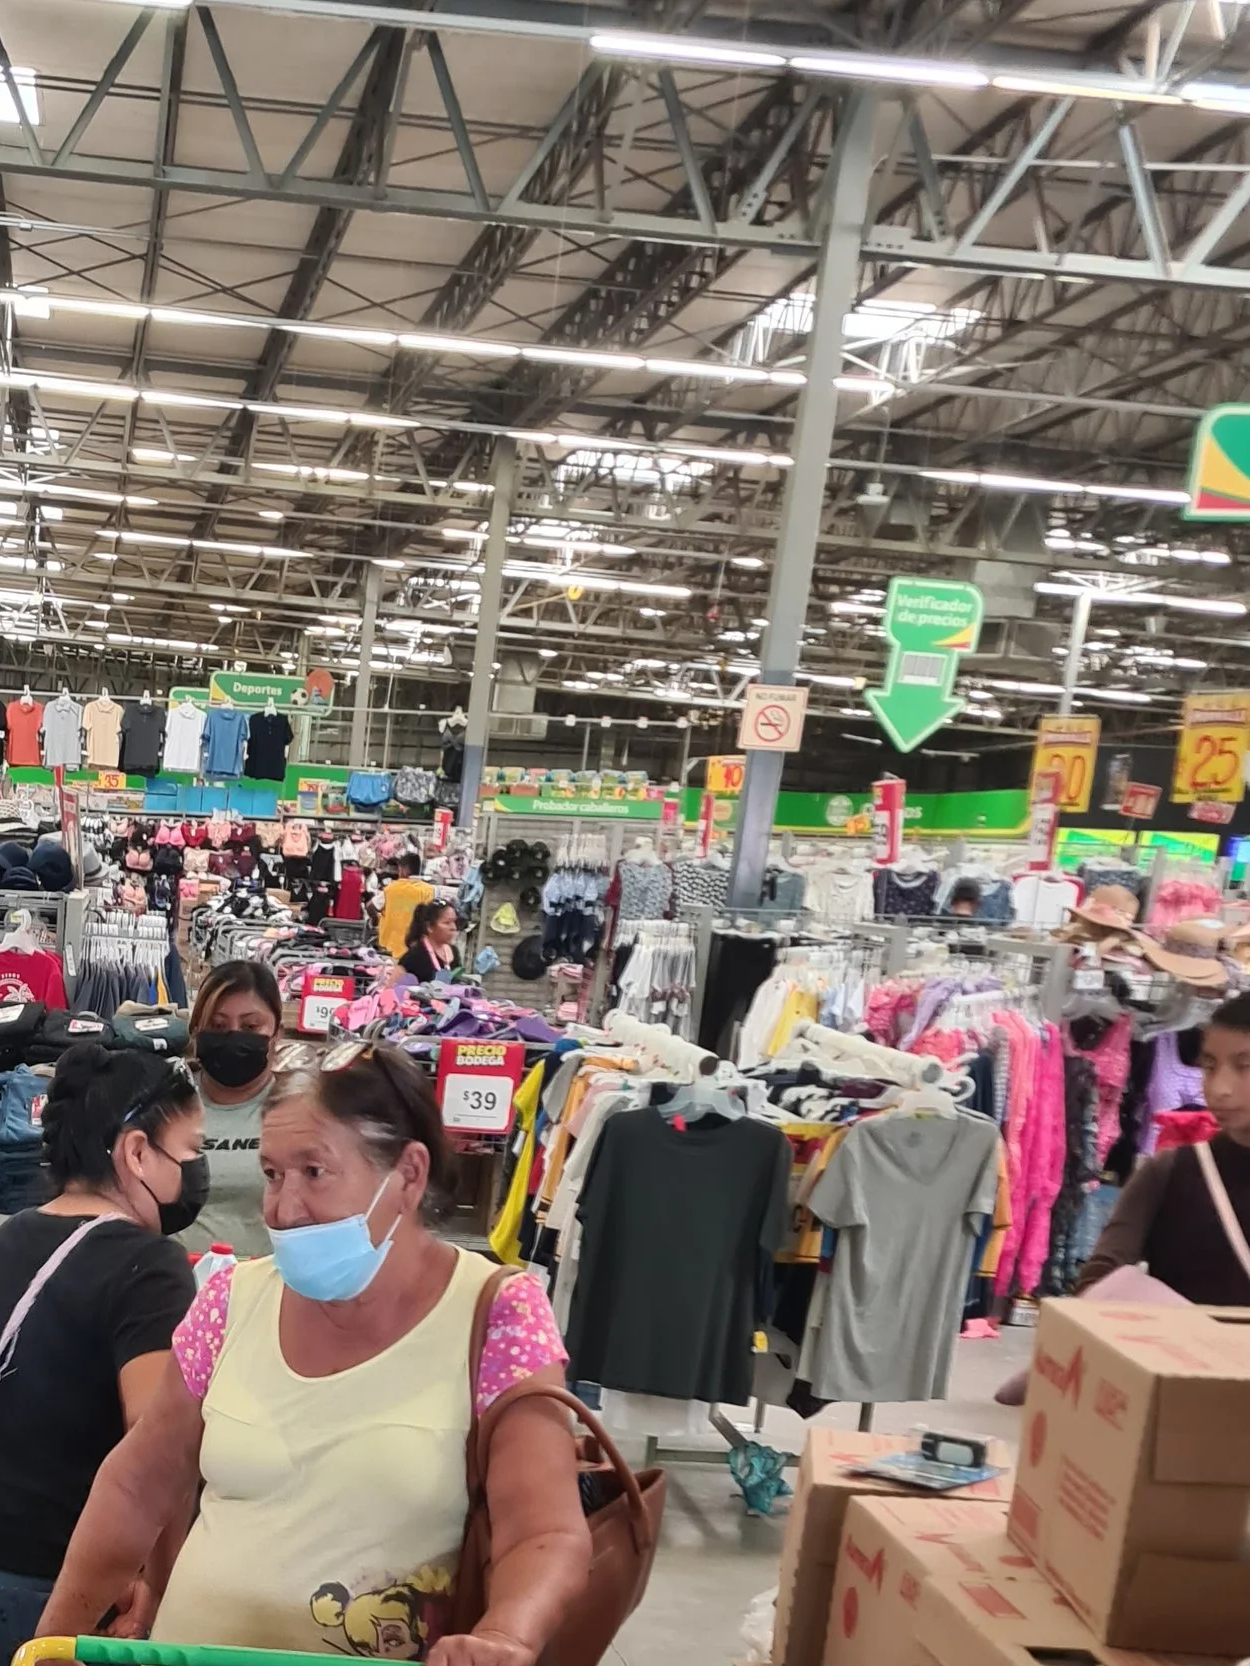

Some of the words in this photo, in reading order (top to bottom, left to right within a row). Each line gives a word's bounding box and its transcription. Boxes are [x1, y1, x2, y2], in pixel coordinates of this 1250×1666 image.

[897, 594, 973, 612] Verificador
[898, 609, 916, 623] de
[917, 613, 968, 627] precios
[233, 682, 283, 697] Deportes
[1190, 735, 1239, 788] 25
[104, 774, 119, 788] 35
[533, 799, 579, 813] Probador
[457, 1045, 506, 1057] PRECIO
[456, 1055, 504, 1066] BODEGA
[463, 1090, 496, 1111] $39
